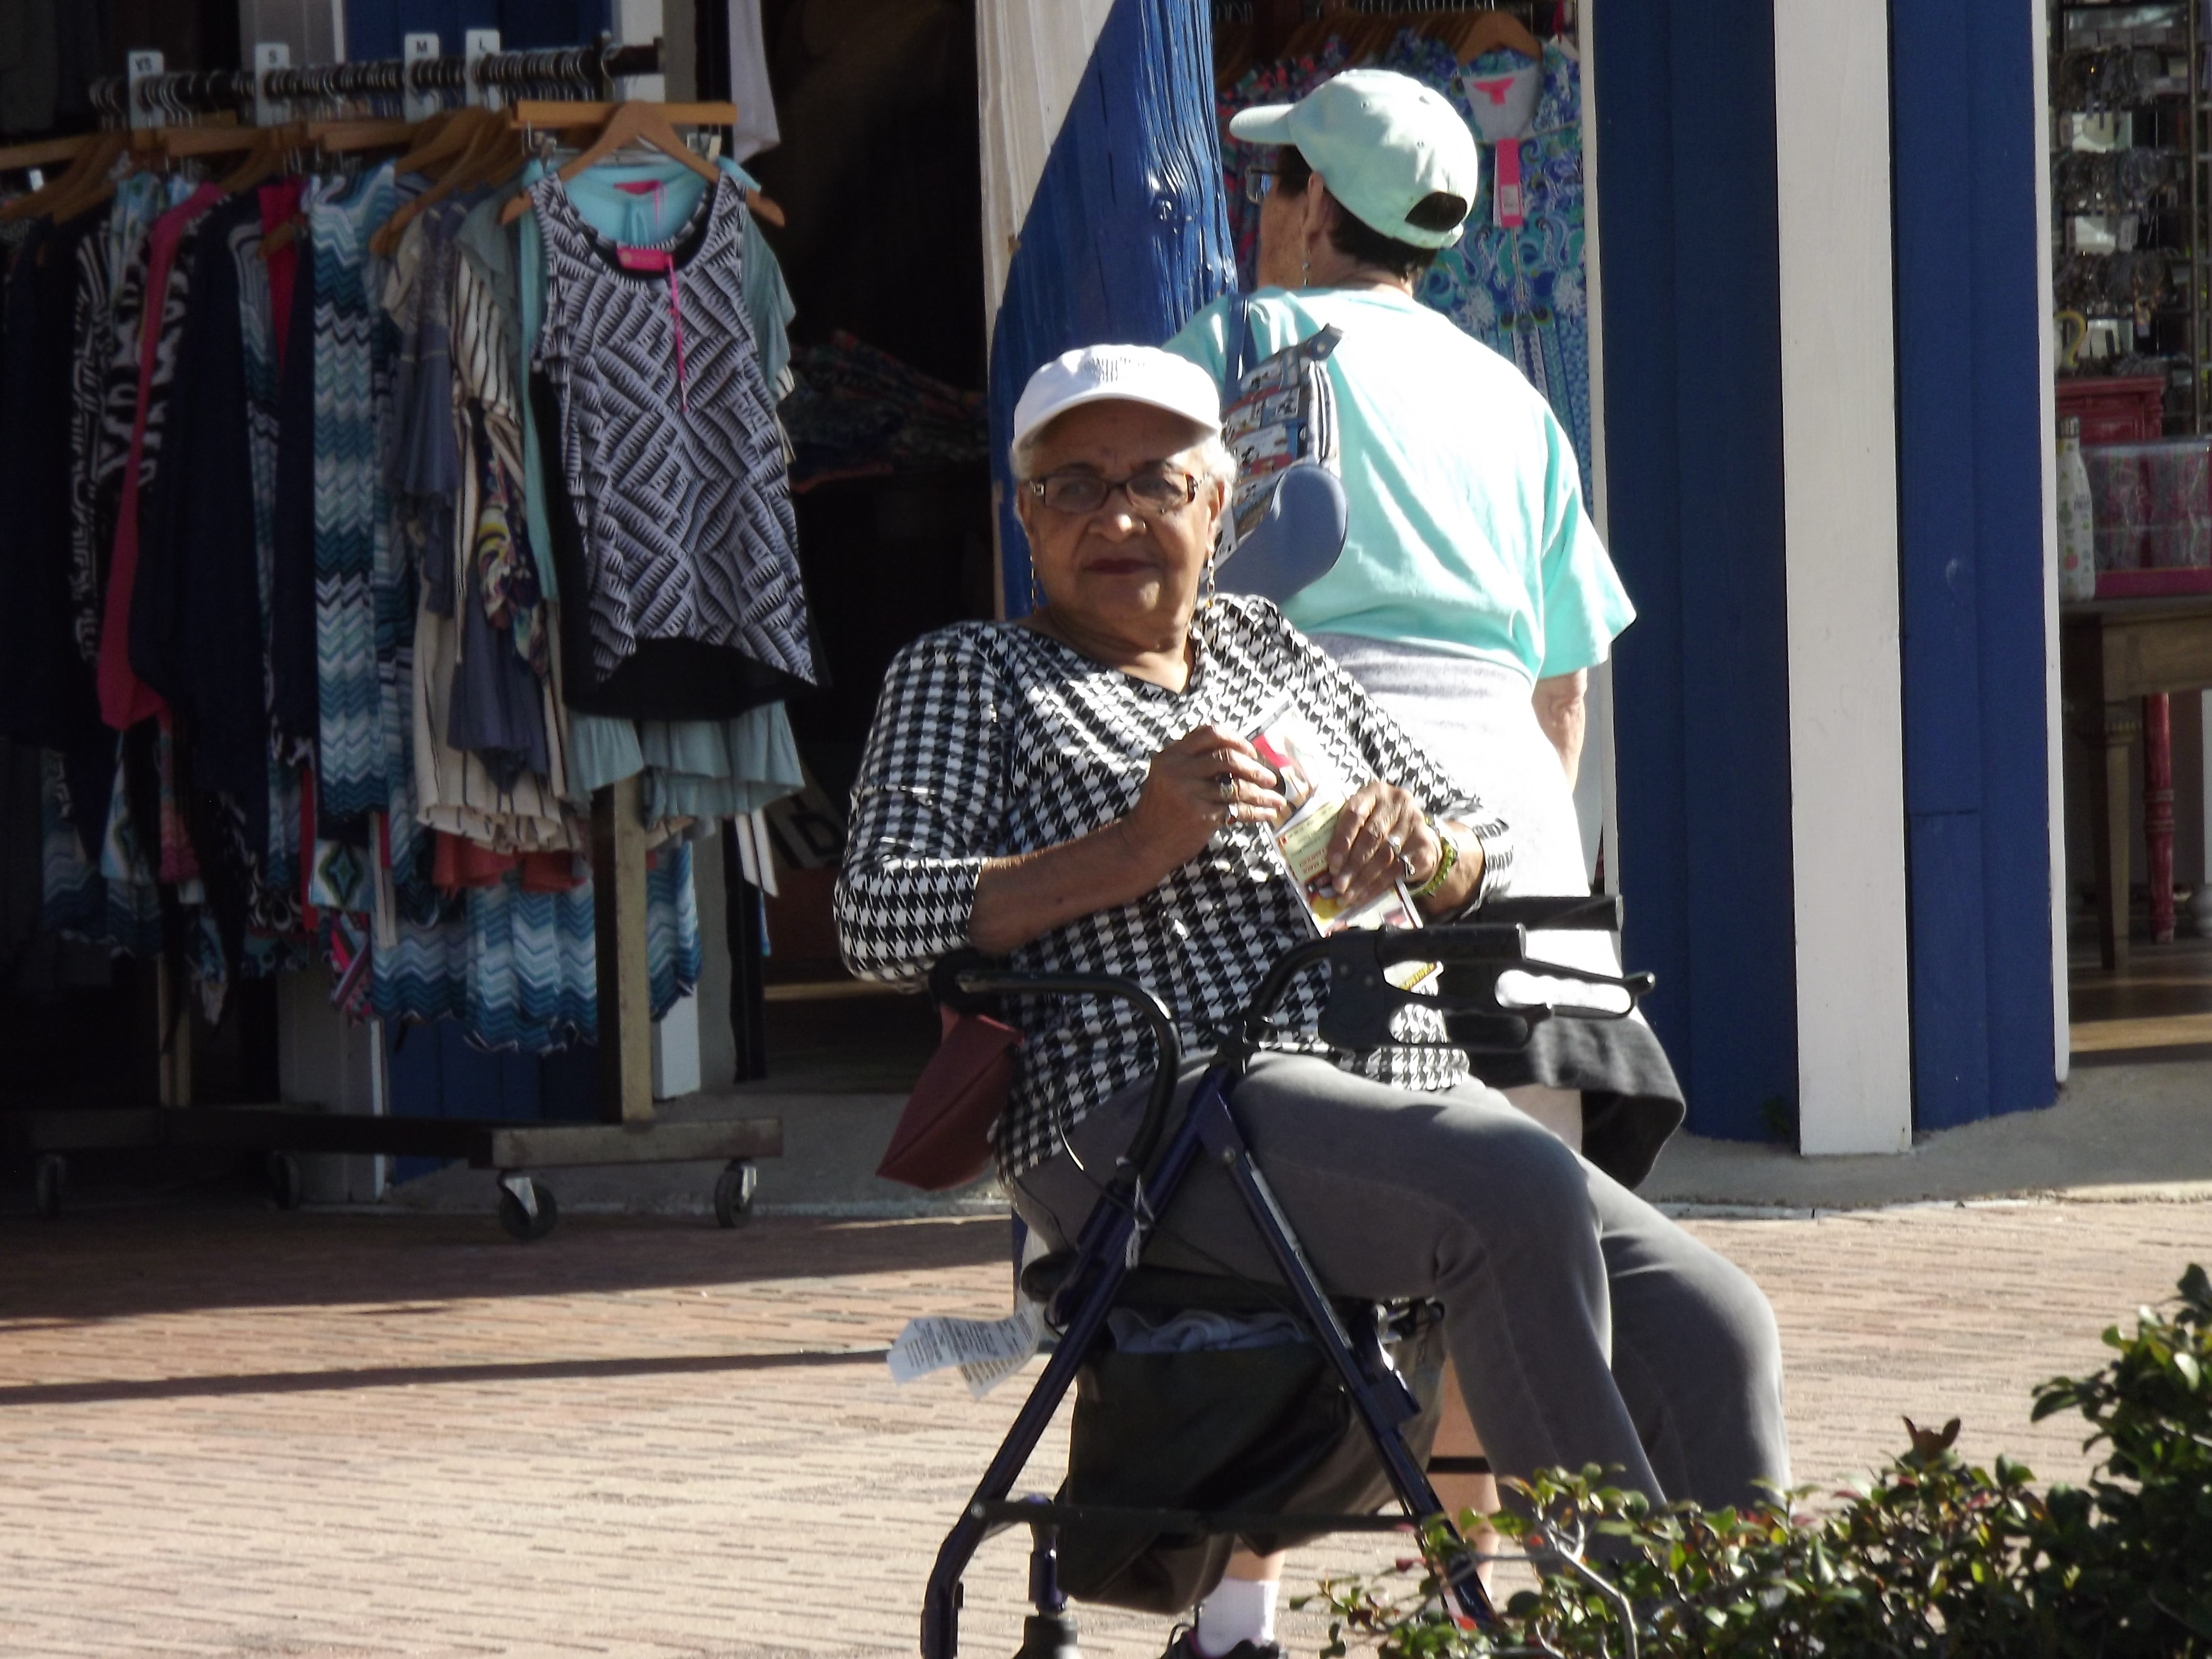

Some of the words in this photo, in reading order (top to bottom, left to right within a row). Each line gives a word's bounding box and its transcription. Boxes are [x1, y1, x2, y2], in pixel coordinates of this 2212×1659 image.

[416, 41, 428, 53] M
[135, 56, 152, 72] XS
[268, 48, 278, 64] S
